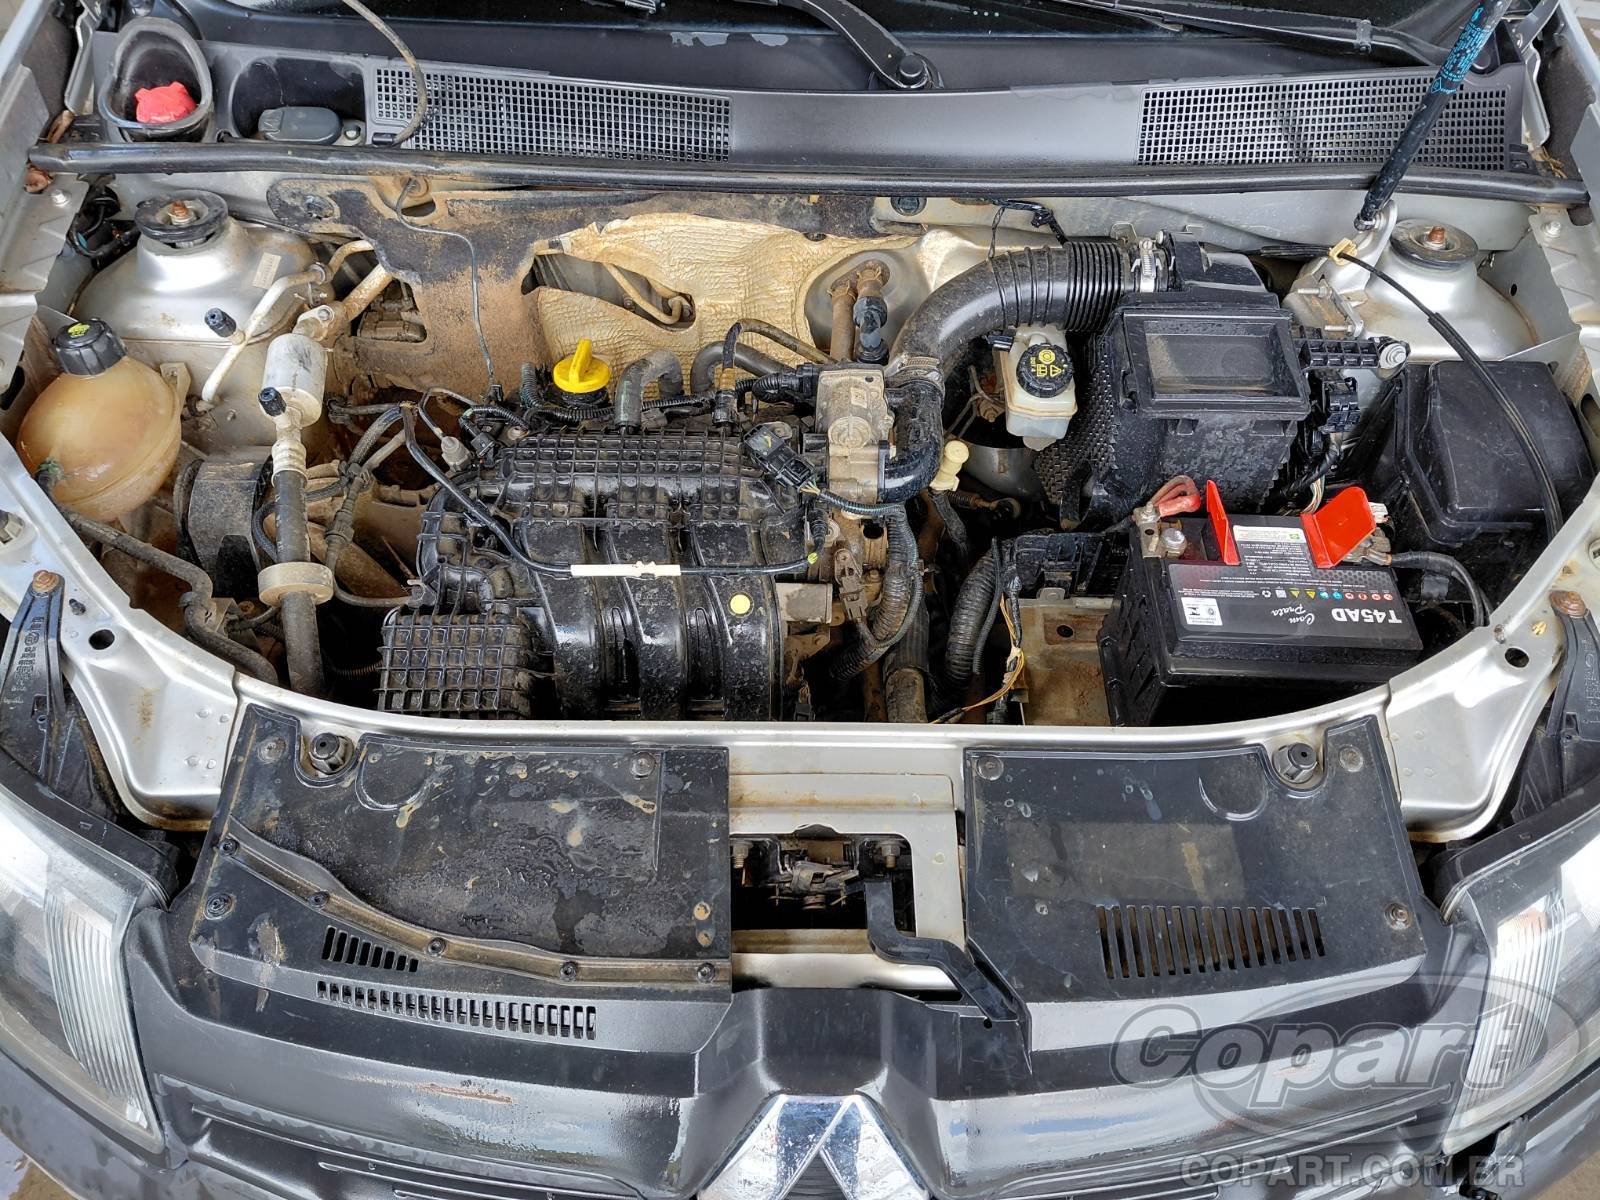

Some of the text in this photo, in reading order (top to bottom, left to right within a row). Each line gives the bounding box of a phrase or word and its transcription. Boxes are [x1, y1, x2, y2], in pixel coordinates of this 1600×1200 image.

[1271, 603, 1306, 617] Prata
[1331, 608, 1403, 624] T45AD
[1288, 613, 1315, 625] Com
